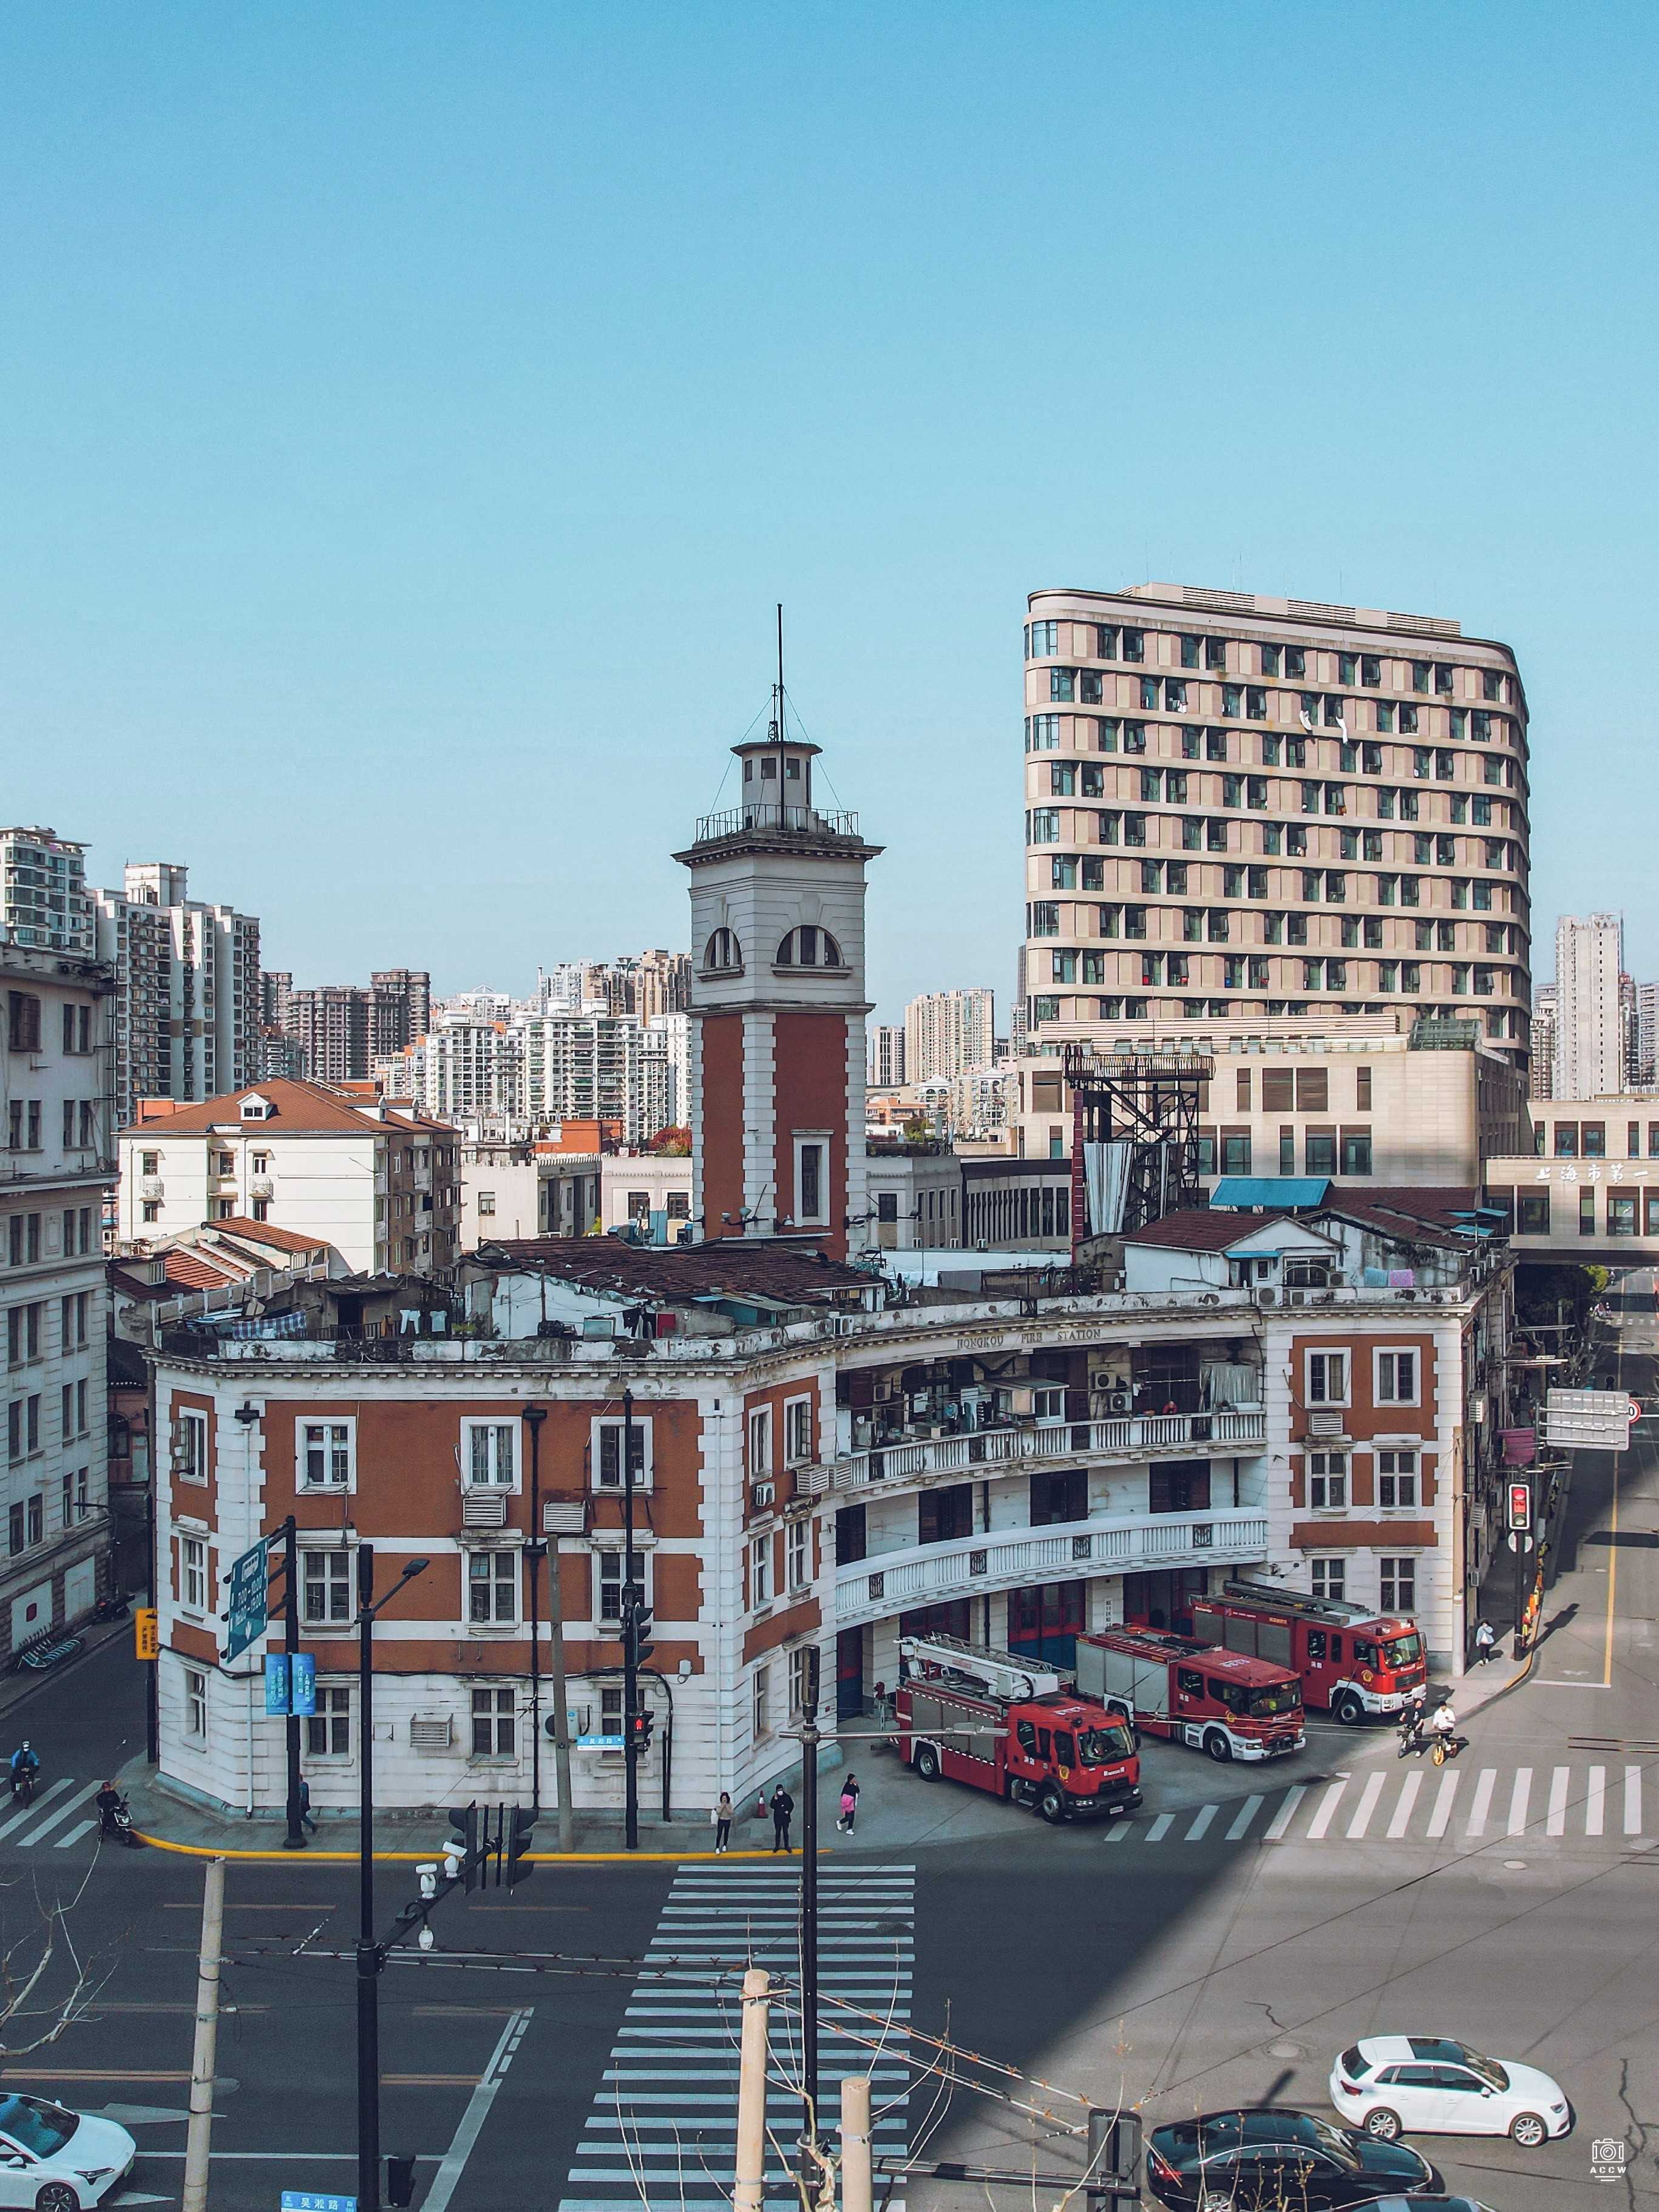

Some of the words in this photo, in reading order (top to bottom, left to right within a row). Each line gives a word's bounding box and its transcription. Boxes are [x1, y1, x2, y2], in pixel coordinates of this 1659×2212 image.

[1535, 1163, 1649, 1184] 上海市第一
[957, 1335, 1004, 1349] HONGKOU
[1057, 1329, 1101, 1341] STATION
[1629, 1406, 1635, 1416] 0
[300, 2197, 338, 2210] 吴淞路
